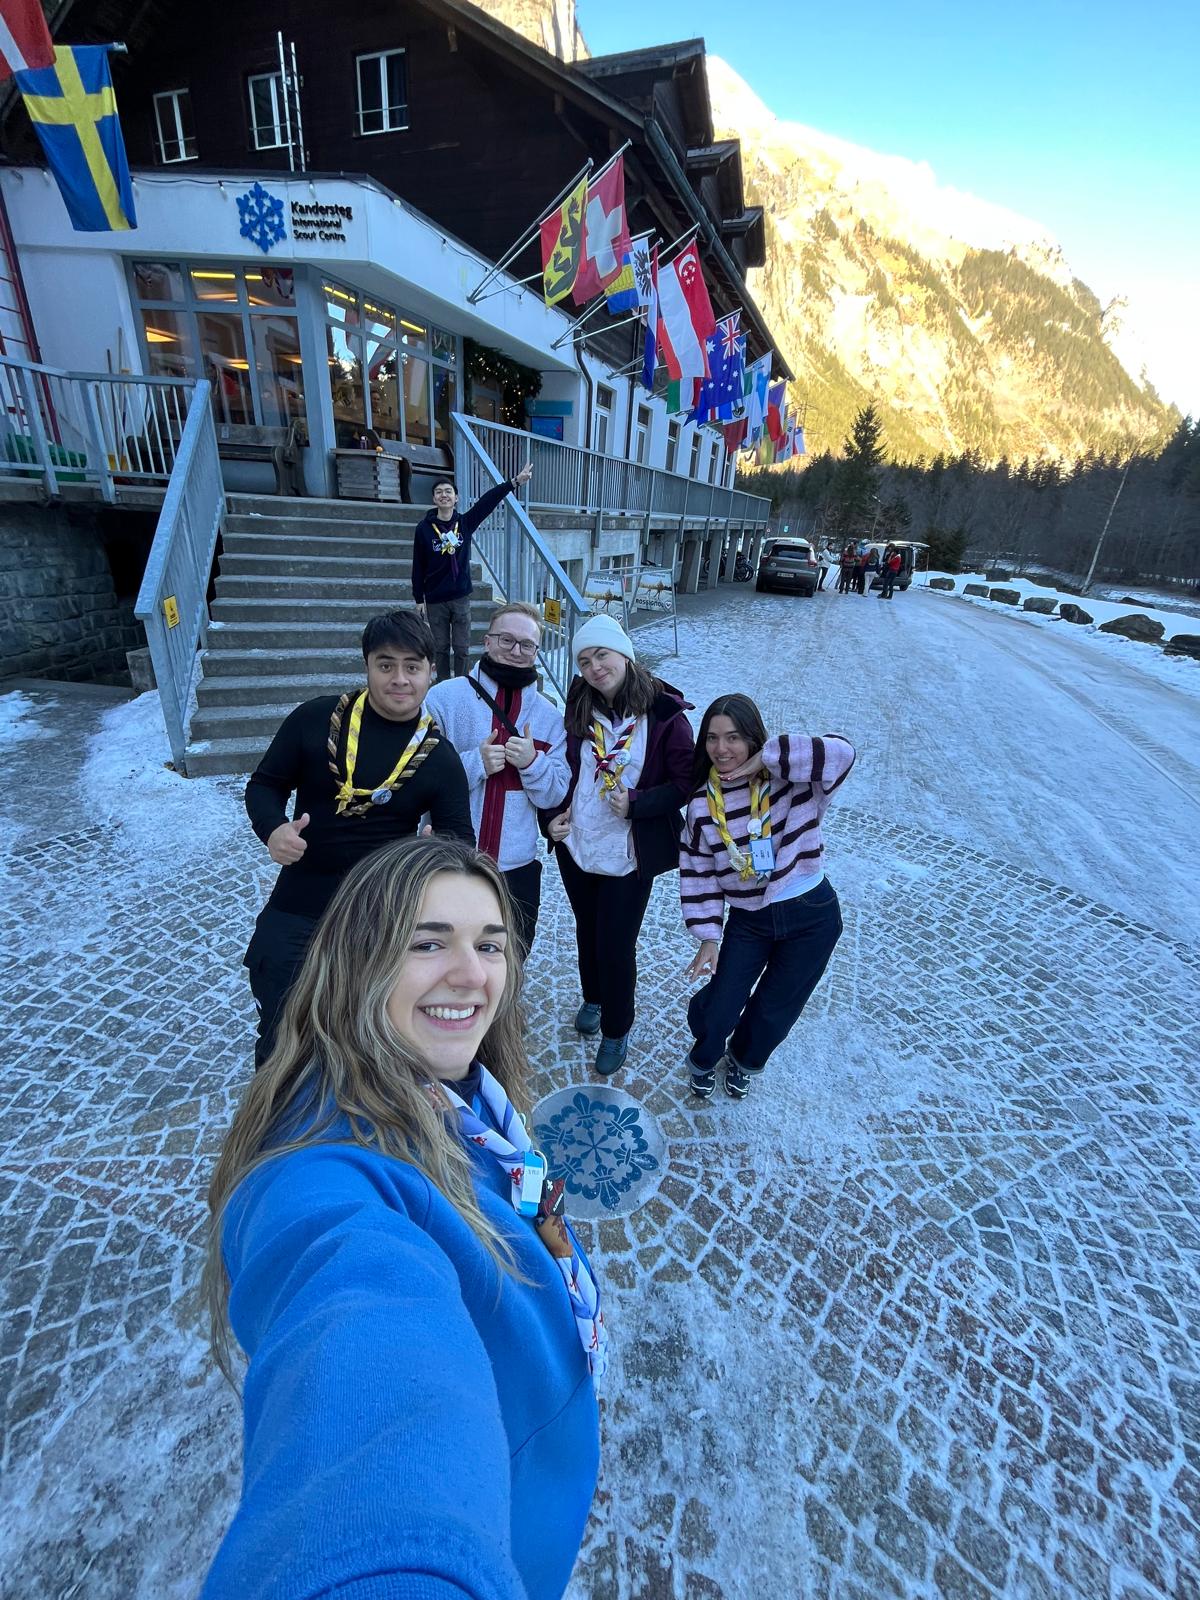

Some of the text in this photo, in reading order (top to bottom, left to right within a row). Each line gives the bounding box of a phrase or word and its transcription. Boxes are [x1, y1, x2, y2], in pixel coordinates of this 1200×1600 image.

[291, 200, 353, 220] Kandersteg
[292, 216, 342, 229] International
[294, 230, 346, 241] Scout Centre
